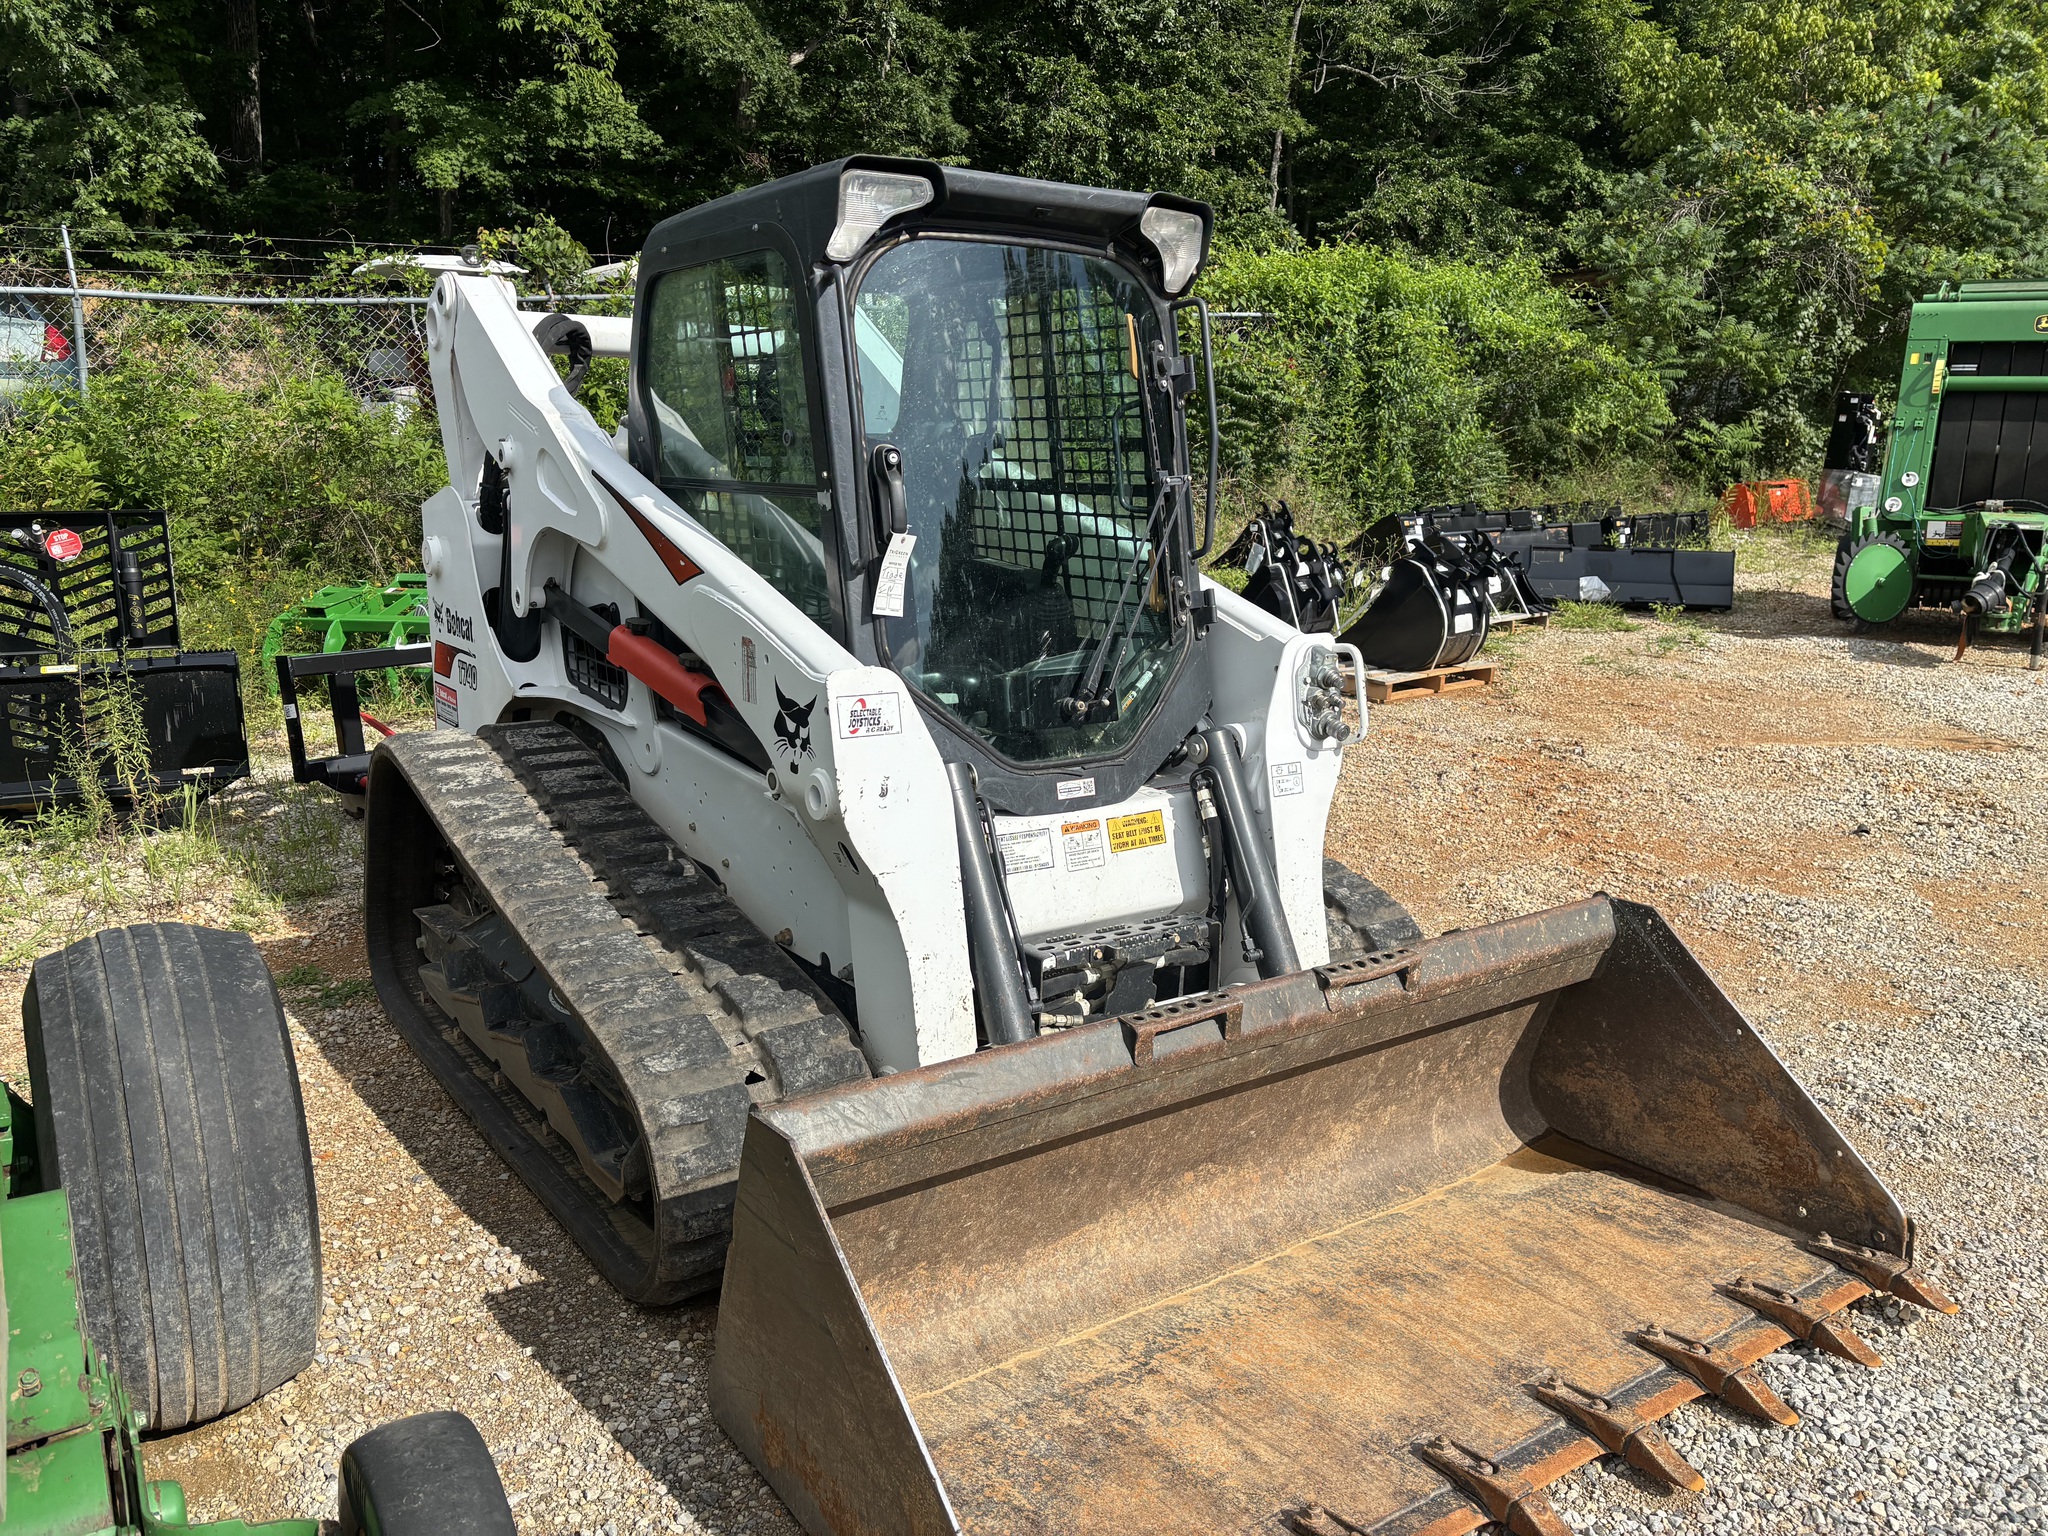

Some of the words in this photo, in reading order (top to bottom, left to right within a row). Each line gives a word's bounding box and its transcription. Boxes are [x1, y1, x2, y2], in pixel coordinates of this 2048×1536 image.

[53, 532, 69, 542] STOP
[446, 607, 474, 643] Bobcat
[458, 659, 478, 691] T740
[850, 707, 882, 718] SELECTABLE
[848, 716, 882, 728] JOYSTICKS
[1070, 821, 1097, 833] WARNING
[1111, 831, 1125, 841] SEAT
[1126, 829, 1138, 838] BELT
[1155, 824, 1162, 833] BE
[1112, 840, 1130, 851] WORN
[1131, 838, 1137, 847] AT
[1138, 837, 1148, 846] ALL
[1148, 833, 1164, 844] TIMES
